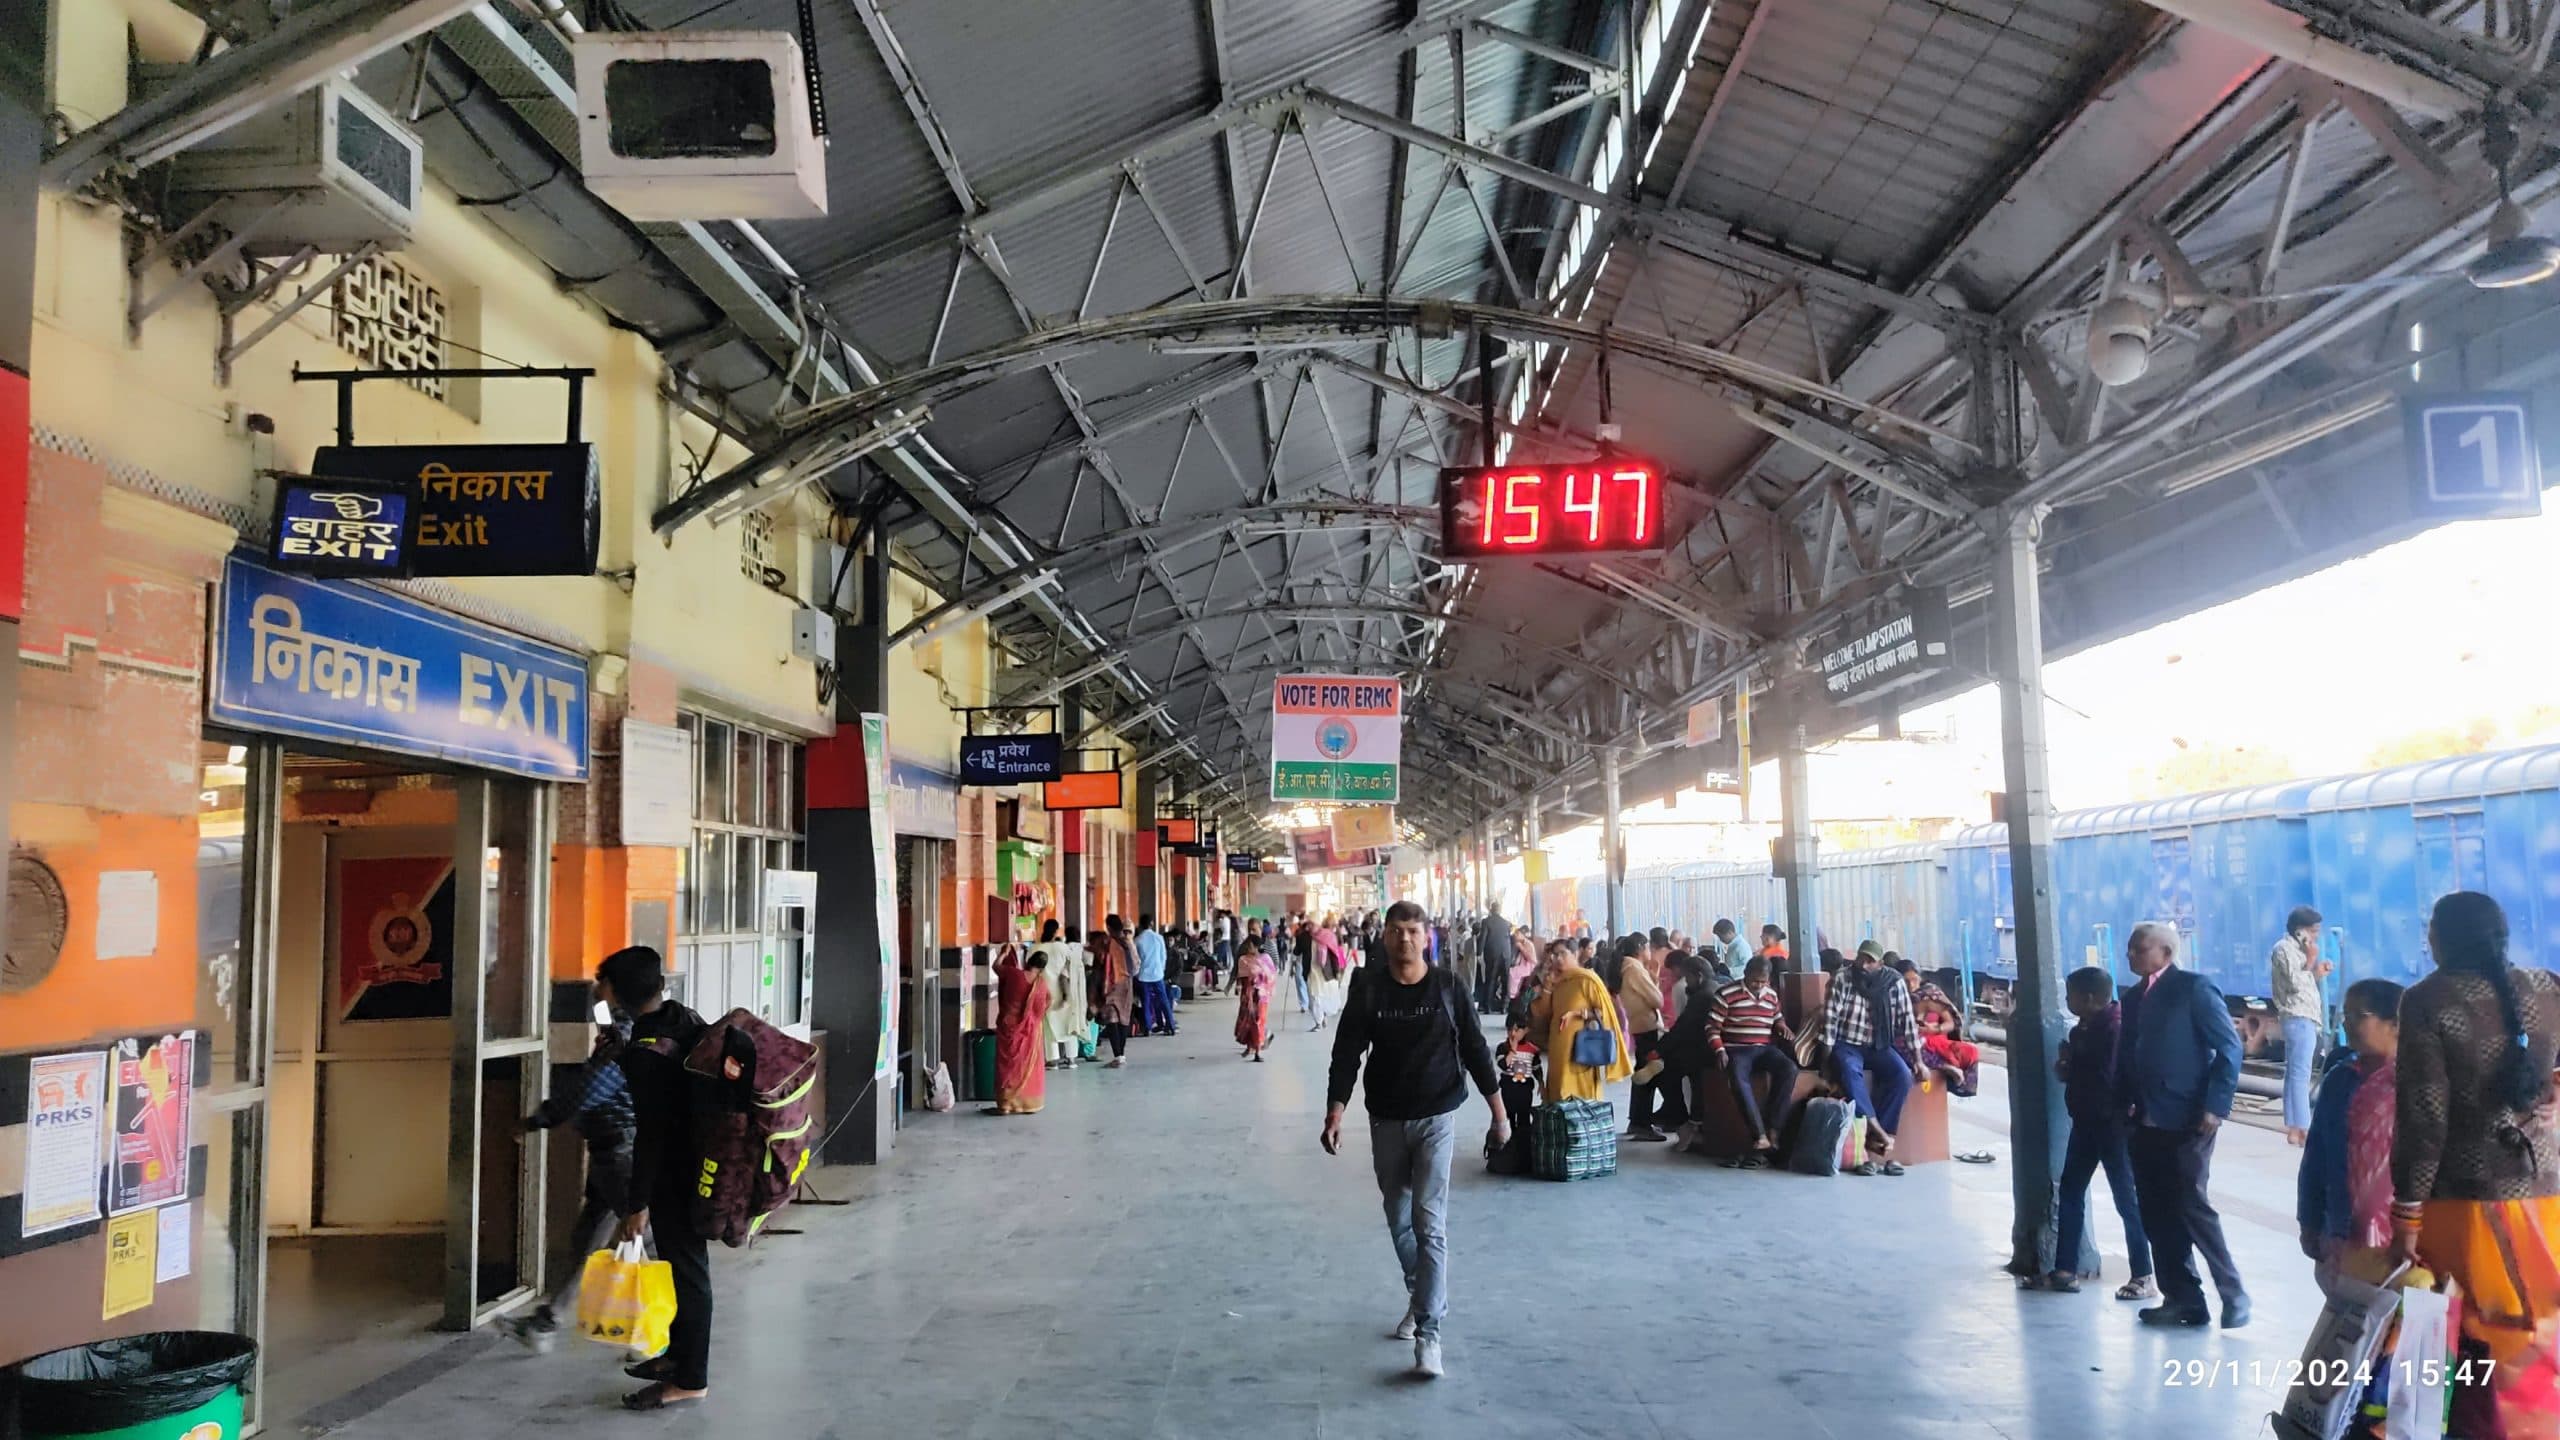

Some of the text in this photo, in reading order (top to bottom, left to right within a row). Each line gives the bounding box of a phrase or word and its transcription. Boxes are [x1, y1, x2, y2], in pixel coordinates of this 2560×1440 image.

[2459, 415, 2499, 488] 1
[417, 462, 553, 502] निकास
[1482, 470, 1649, 545] 15 47
[287, 516, 399, 543] बाहर
[416, 513, 489, 546] Exit
[282, 537, 397, 560] EXIT
[248, 594, 422, 715] निकास
[1822, 643, 1856, 673] WELCOME
[1855, 638, 1866, 658] TO
[1879, 614, 1913, 647] STATION
[458, 652, 576, 745] EXIT
[1281, 684, 1393, 709] VOTE FOR ERMC
[998, 741, 1031, 758] प्रवेश
[998, 761, 1051, 773] Entrance
[1706, 772, 1741, 789] PF-
[35, 1106, 93, 1127] PRKS
